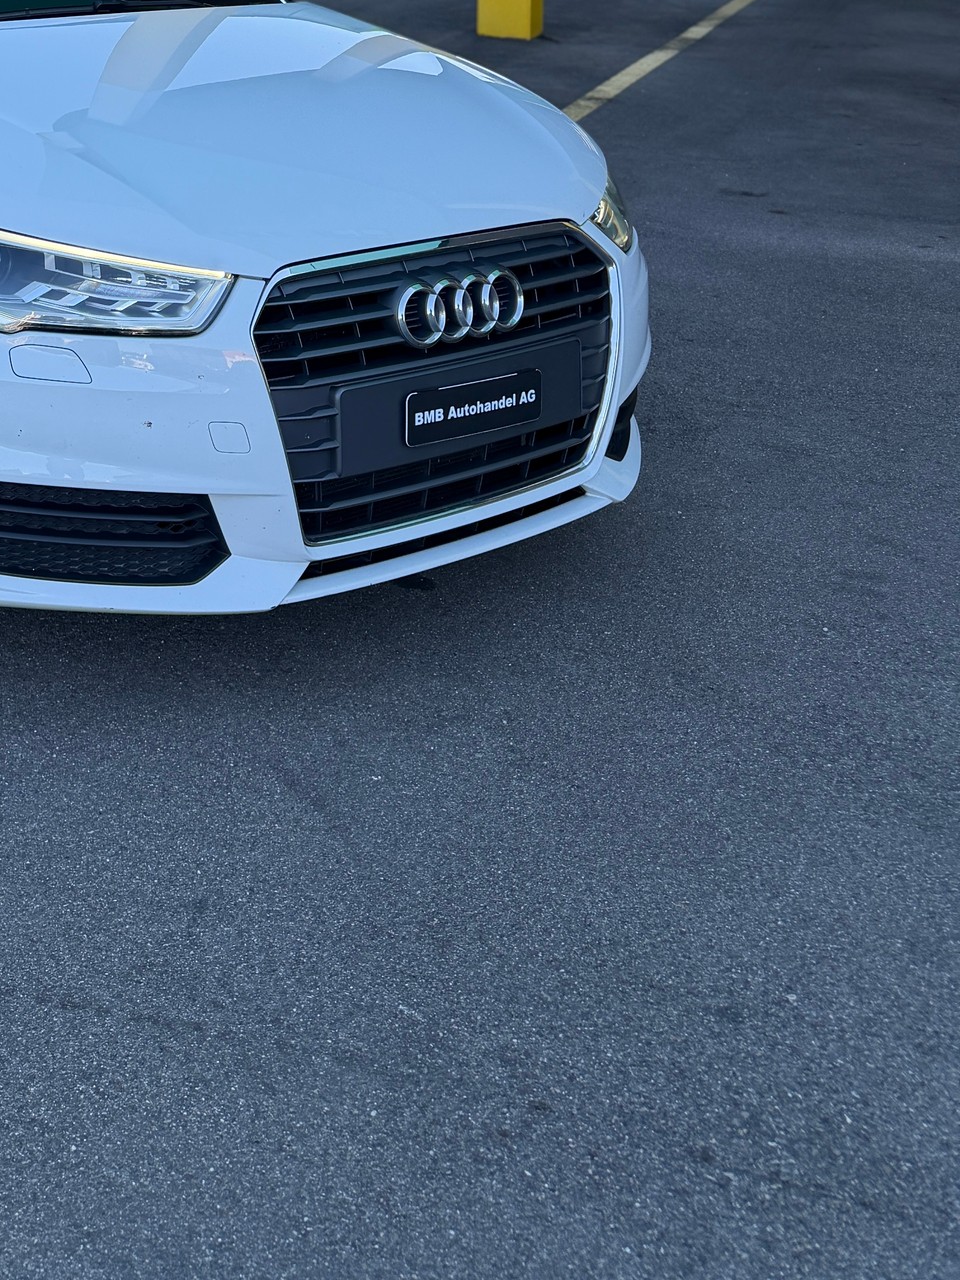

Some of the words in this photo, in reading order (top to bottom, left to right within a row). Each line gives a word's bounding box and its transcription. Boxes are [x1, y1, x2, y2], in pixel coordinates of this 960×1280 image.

[415, 408, 444, 426] BMB
[447, 394, 516, 419] Autohandel
[519, 389, 536, 405] AG
